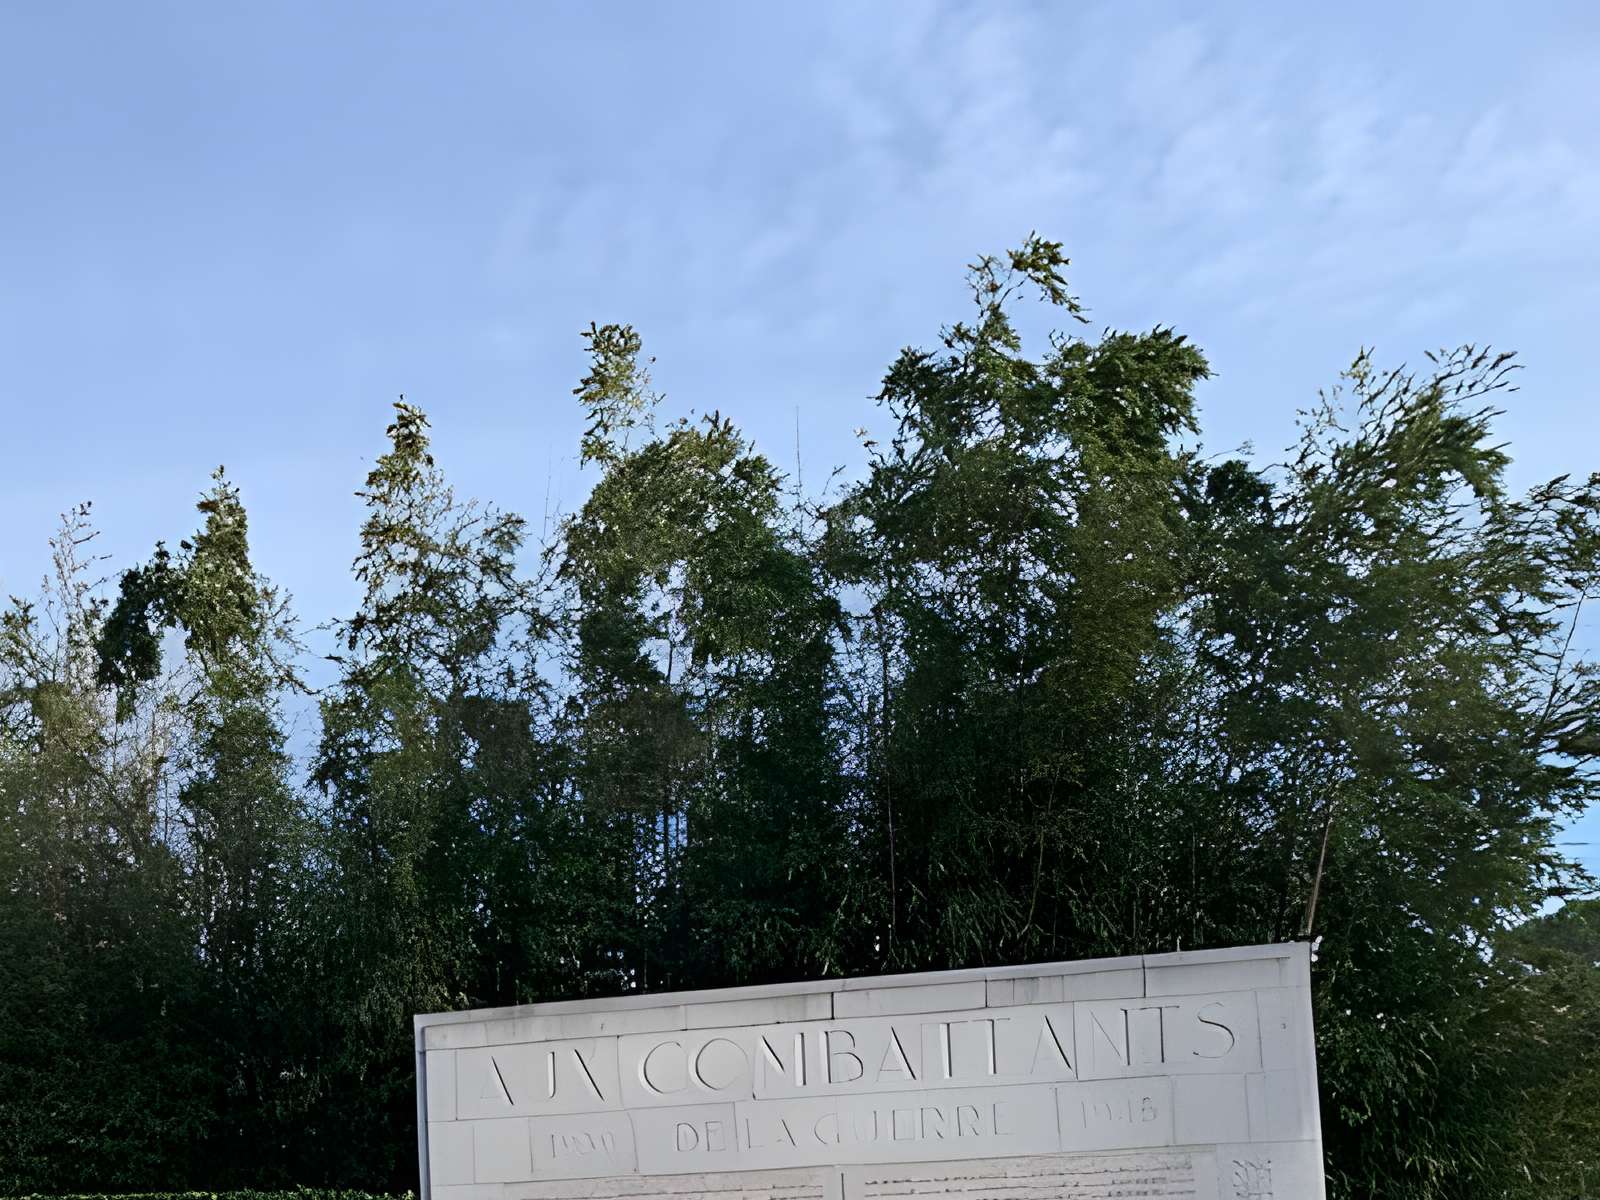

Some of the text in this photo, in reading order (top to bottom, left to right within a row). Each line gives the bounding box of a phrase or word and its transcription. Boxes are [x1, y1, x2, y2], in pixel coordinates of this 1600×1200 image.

[480, 1002, 1236, 1106] AUX COMBATTANTS
[676, 1120, 727, 1152] DE
[745, 1118, 797, 1150] LA
